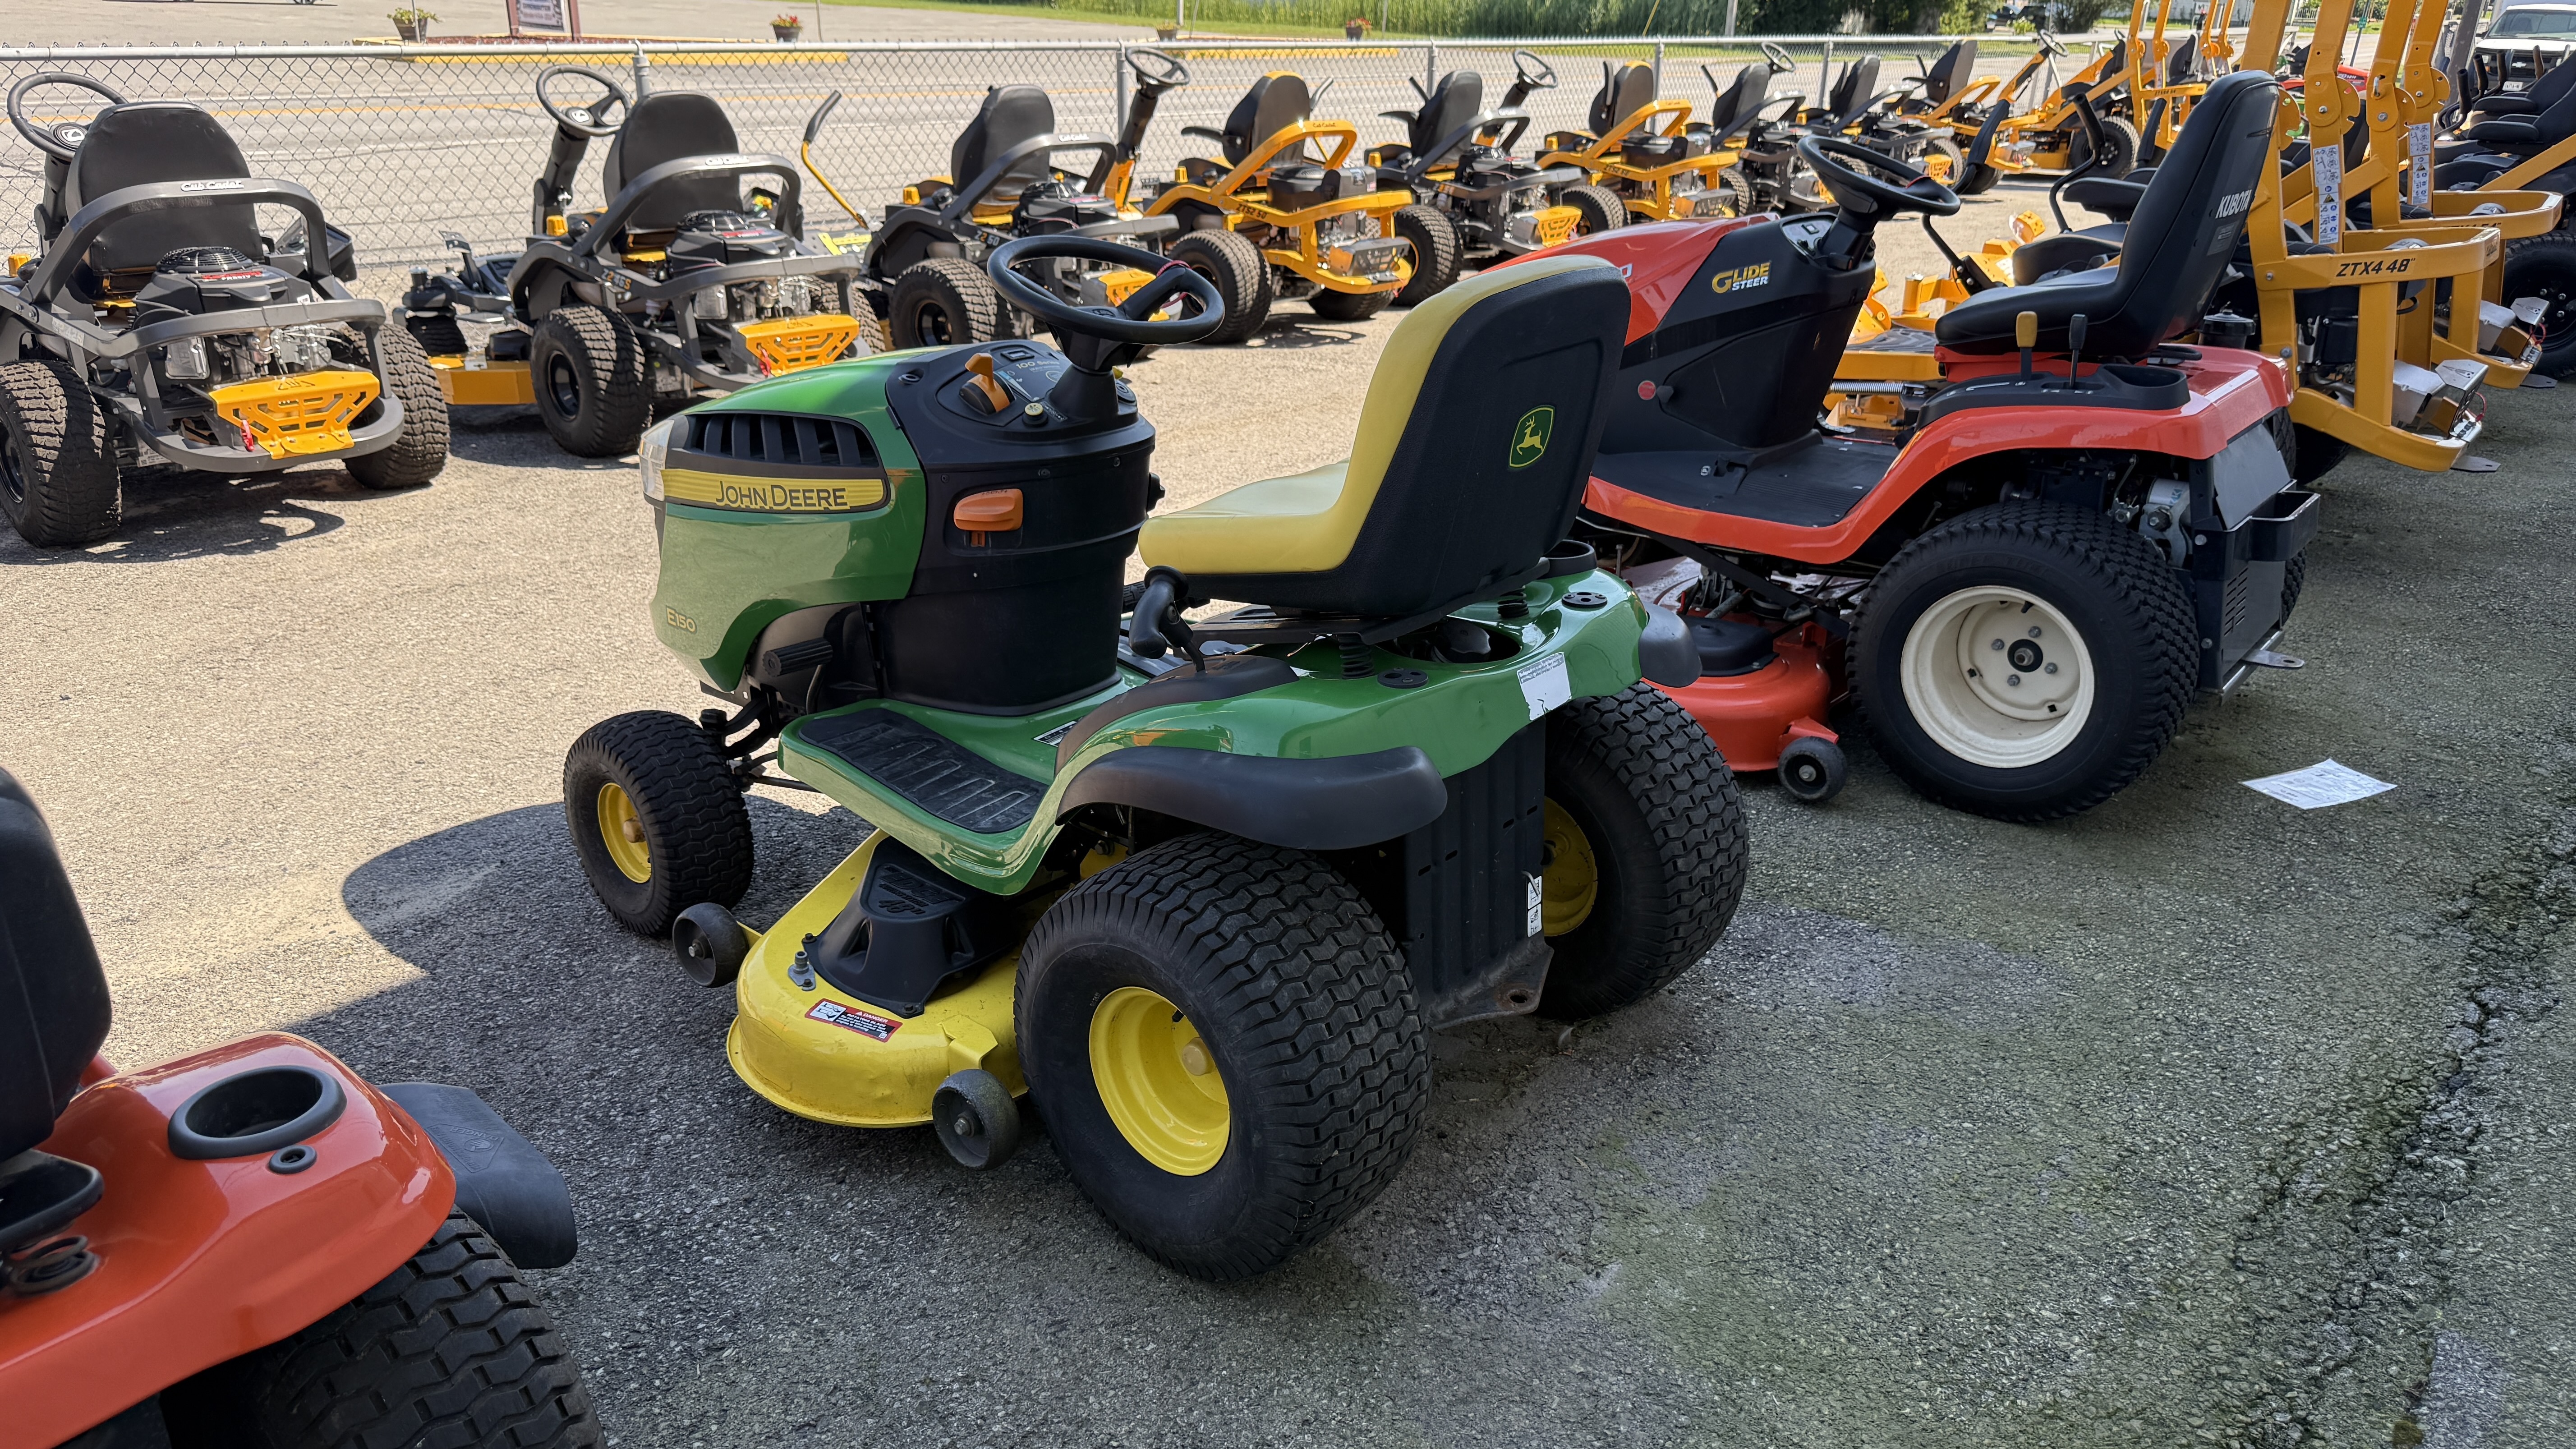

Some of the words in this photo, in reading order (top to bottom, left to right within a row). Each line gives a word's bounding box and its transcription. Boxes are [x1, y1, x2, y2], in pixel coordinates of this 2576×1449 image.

[181, 182, 205, 192] Cub
[206, 180, 244, 190] Cadet
[2215, 189, 2252, 219] KUBOTA
[1711, 262, 1771, 294] GLIDE
[2336, 260, 2384, 277] ZTX4
[2385, 258, 2416, 273] 48"
[1732, 276, 1769, 291] STEER
[716, 480, 768, 506] JOHN
[770, 484, 848, 507] DEERE
[666, 607, 696, 632] E150
[862, 1013, 888, 1023] DANGER
